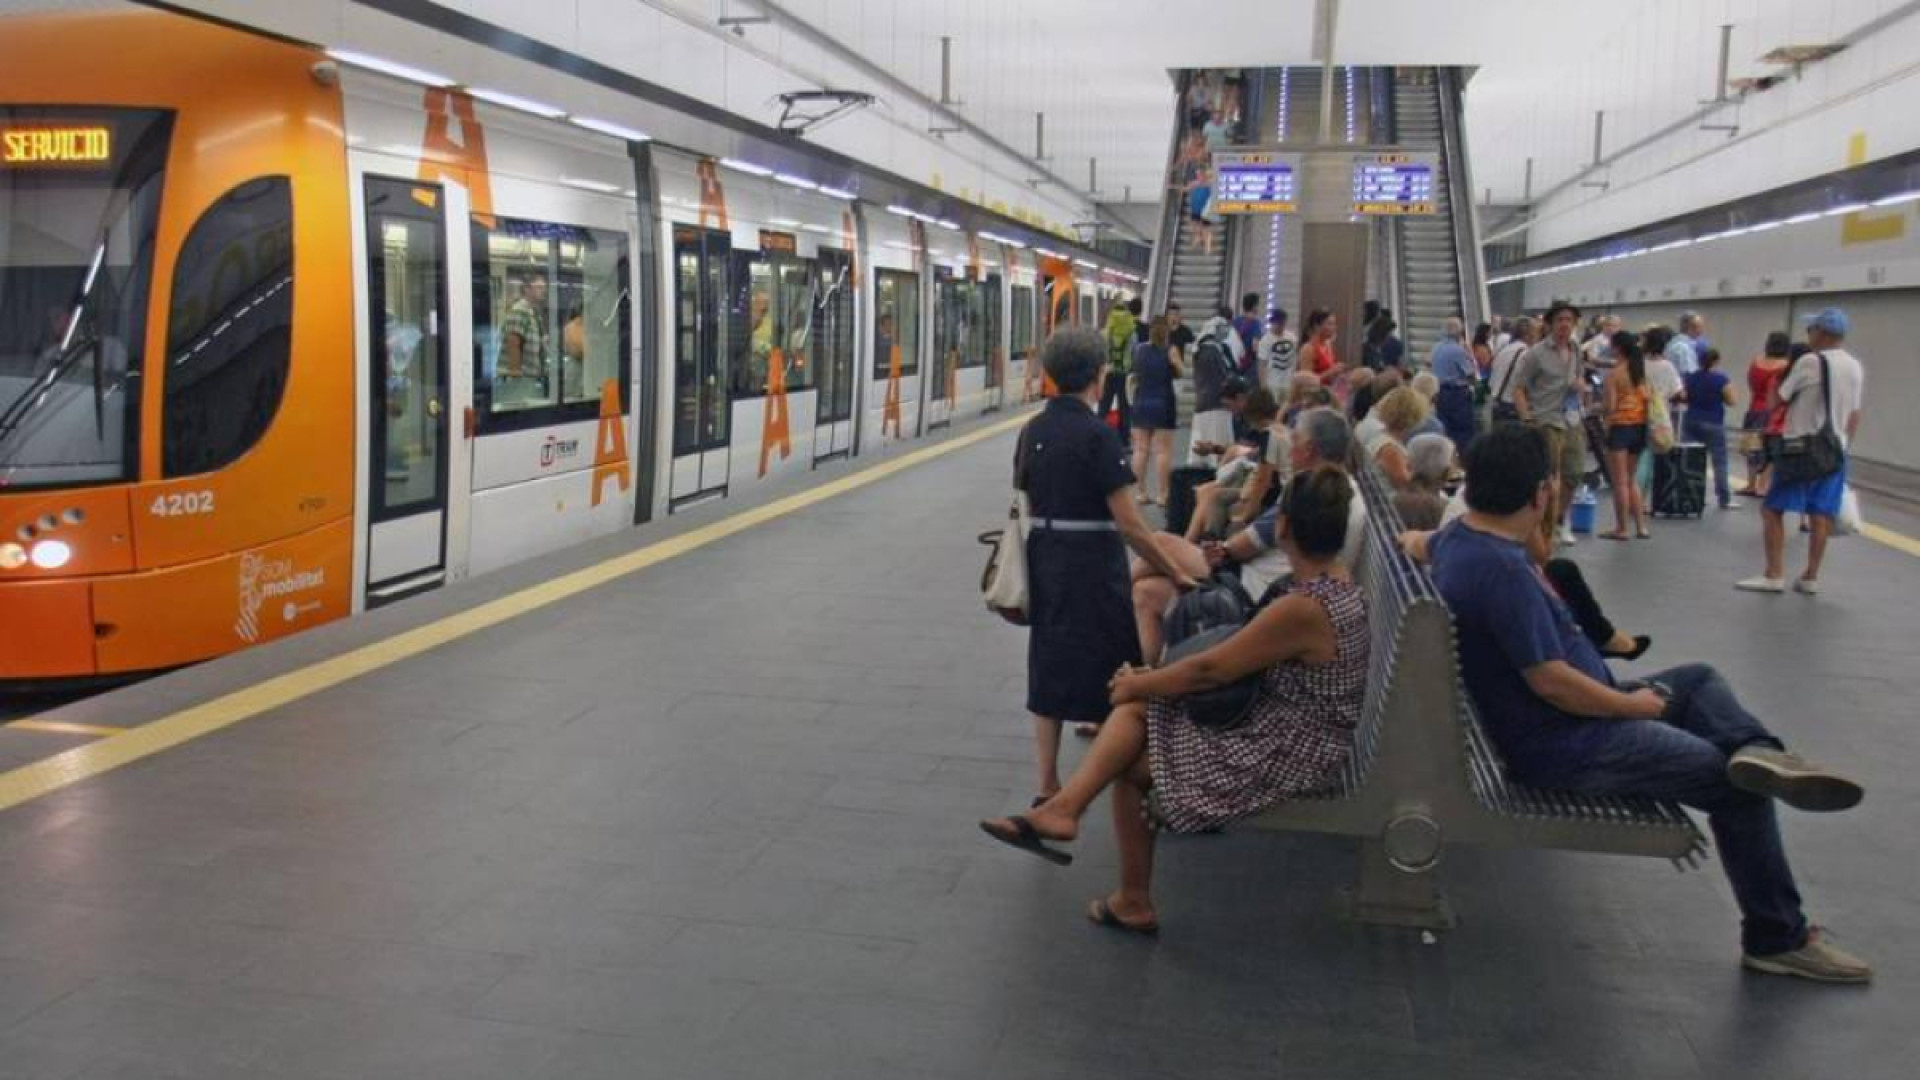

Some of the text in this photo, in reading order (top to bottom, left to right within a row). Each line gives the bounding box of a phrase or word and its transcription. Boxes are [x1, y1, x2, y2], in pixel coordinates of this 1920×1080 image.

[4, 128, 109, 161] SERVICIO
[591, 378, 631, 507] A
[151, 490, 214, 518] 4202
